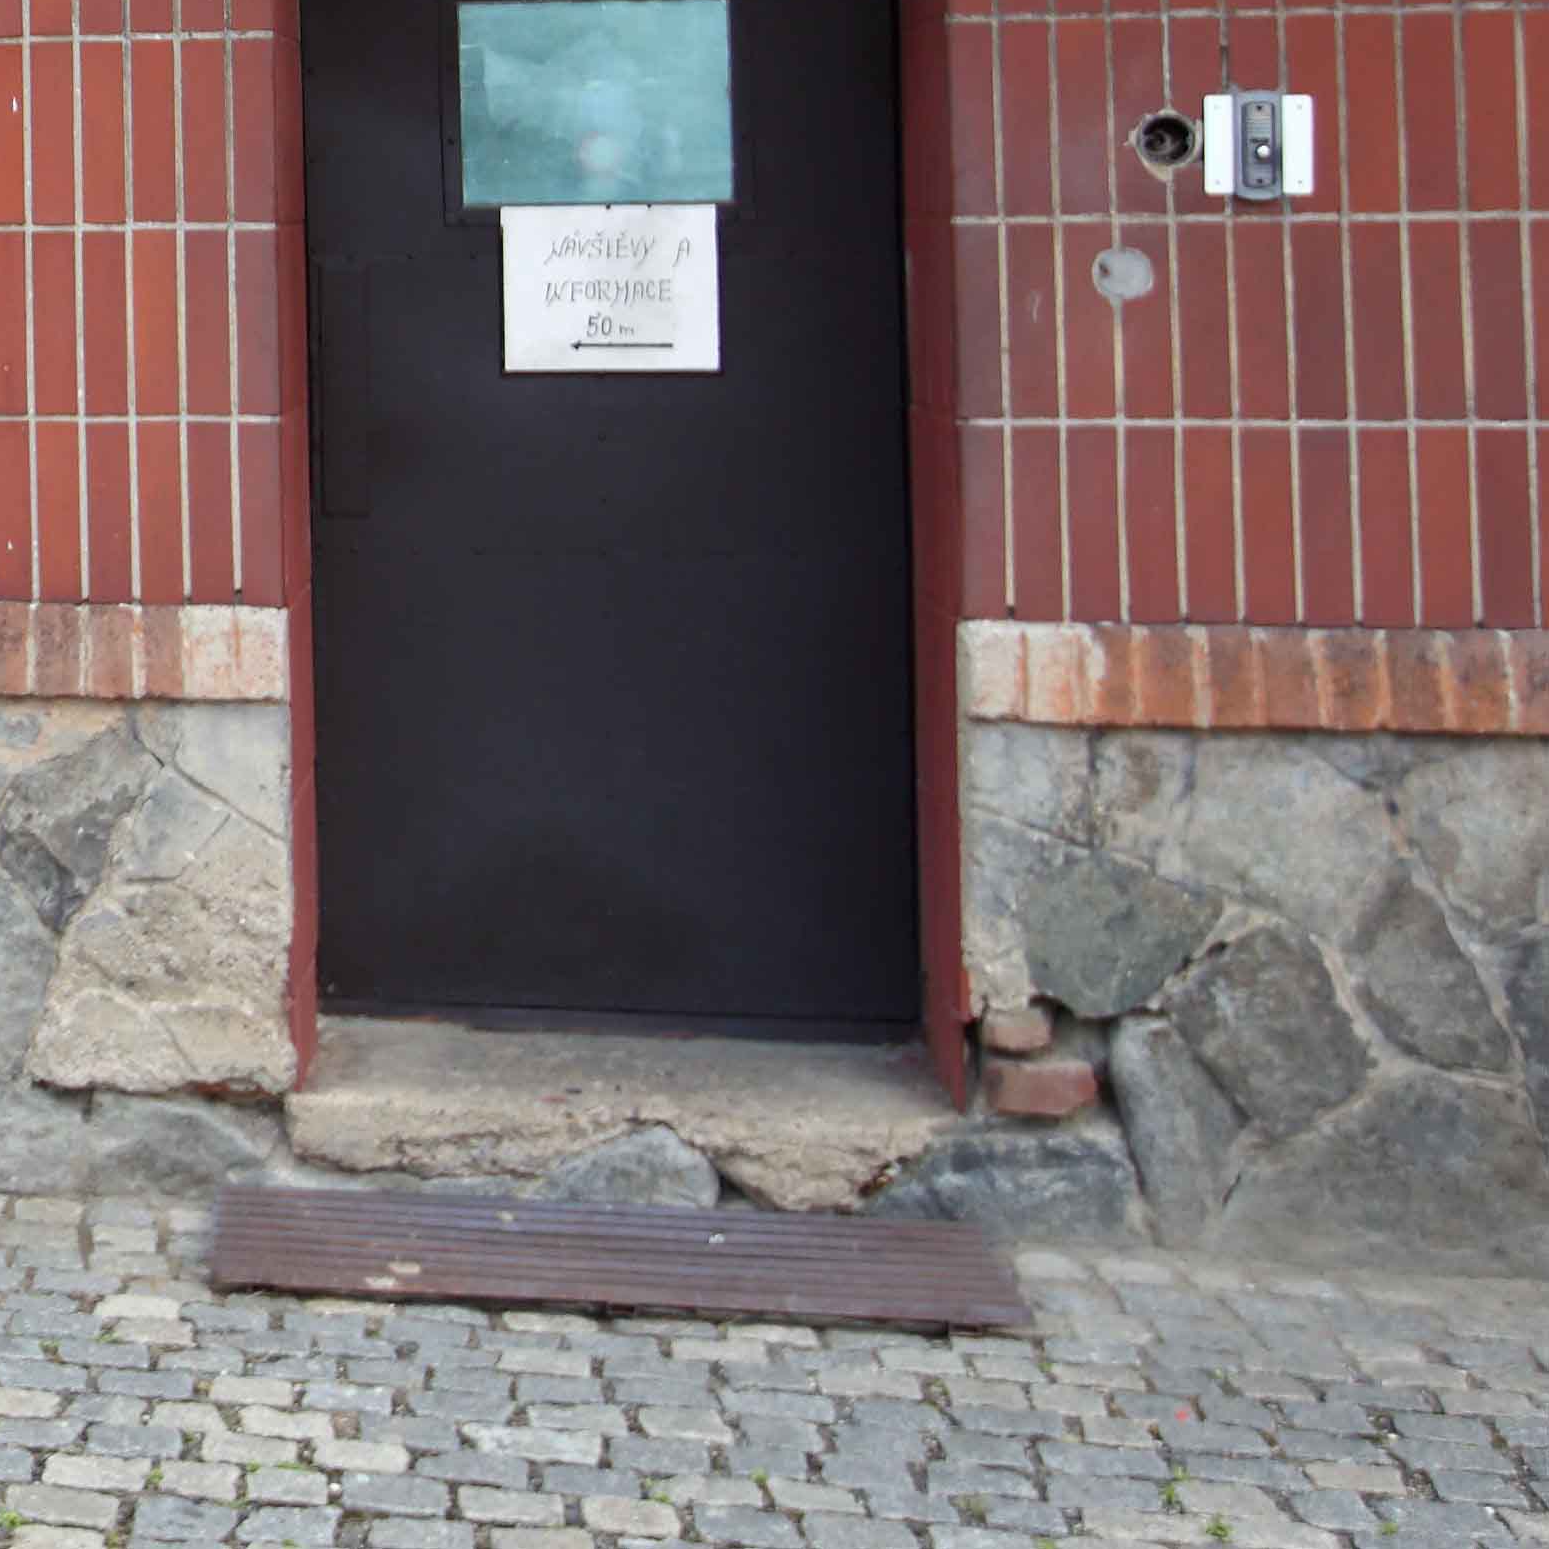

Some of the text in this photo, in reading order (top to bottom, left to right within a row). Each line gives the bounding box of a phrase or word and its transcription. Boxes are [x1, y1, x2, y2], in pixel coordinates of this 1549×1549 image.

[672, 236, 692, 267] A
[544, 278, 672, 307] INFORMACE
[586, 312, 613, 337] 50
